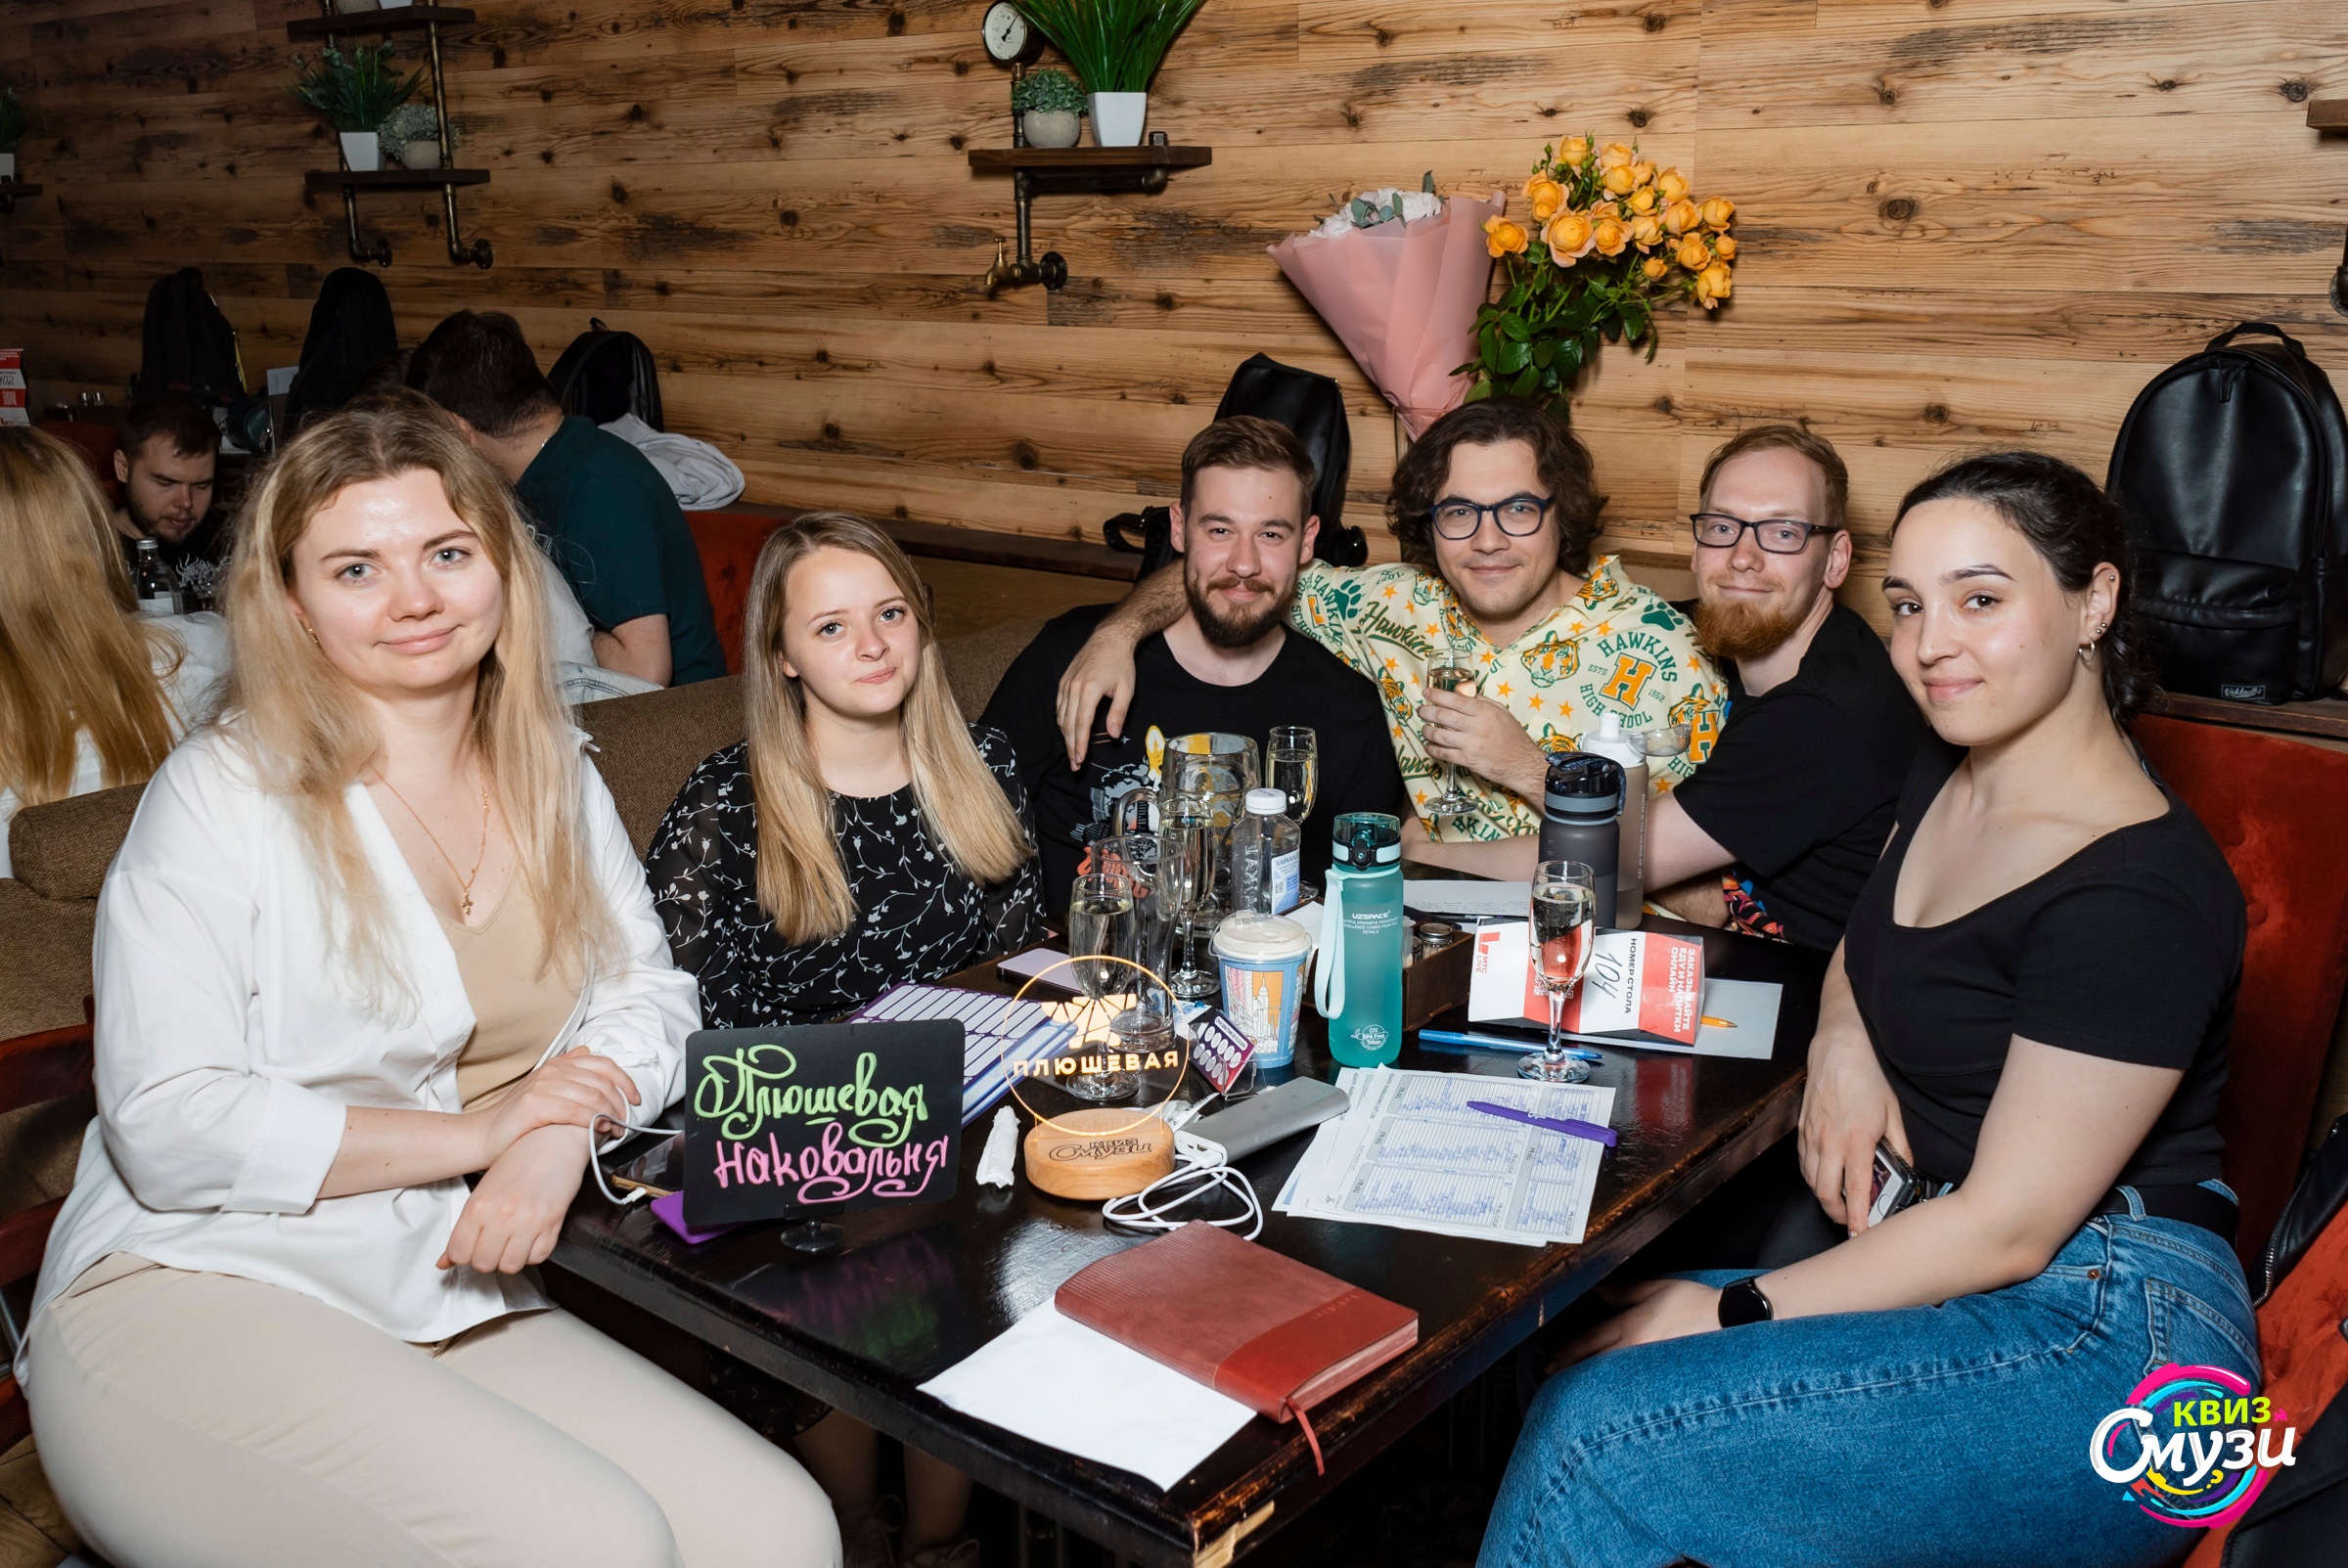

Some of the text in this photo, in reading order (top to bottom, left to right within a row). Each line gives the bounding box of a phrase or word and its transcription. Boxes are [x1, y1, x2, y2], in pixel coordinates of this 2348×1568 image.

[1588, 664, 1607, 676] ESTD
[1597, 631, 1678, 683] HAWKINS
[1648, 689, 1666, 703] 1952
[1667, 755, 1696, 778] HIG
[1592, 953, 1622, 999] 104
[1625, 938, 1638, 1013] НОМЕР СТОЛА
[1668, 946, 1679, 993] ОНЛАЙН
[1674, 947, 1688, 1033] ЕДУ И НАПИТКИ
[1013, 1051, 1179, 1077] ПЛЮШЕВАЯ
[694, 1044, 928, 1147] Плюшевая
[1090, 1138, 1138, 1148] КВИЗ
